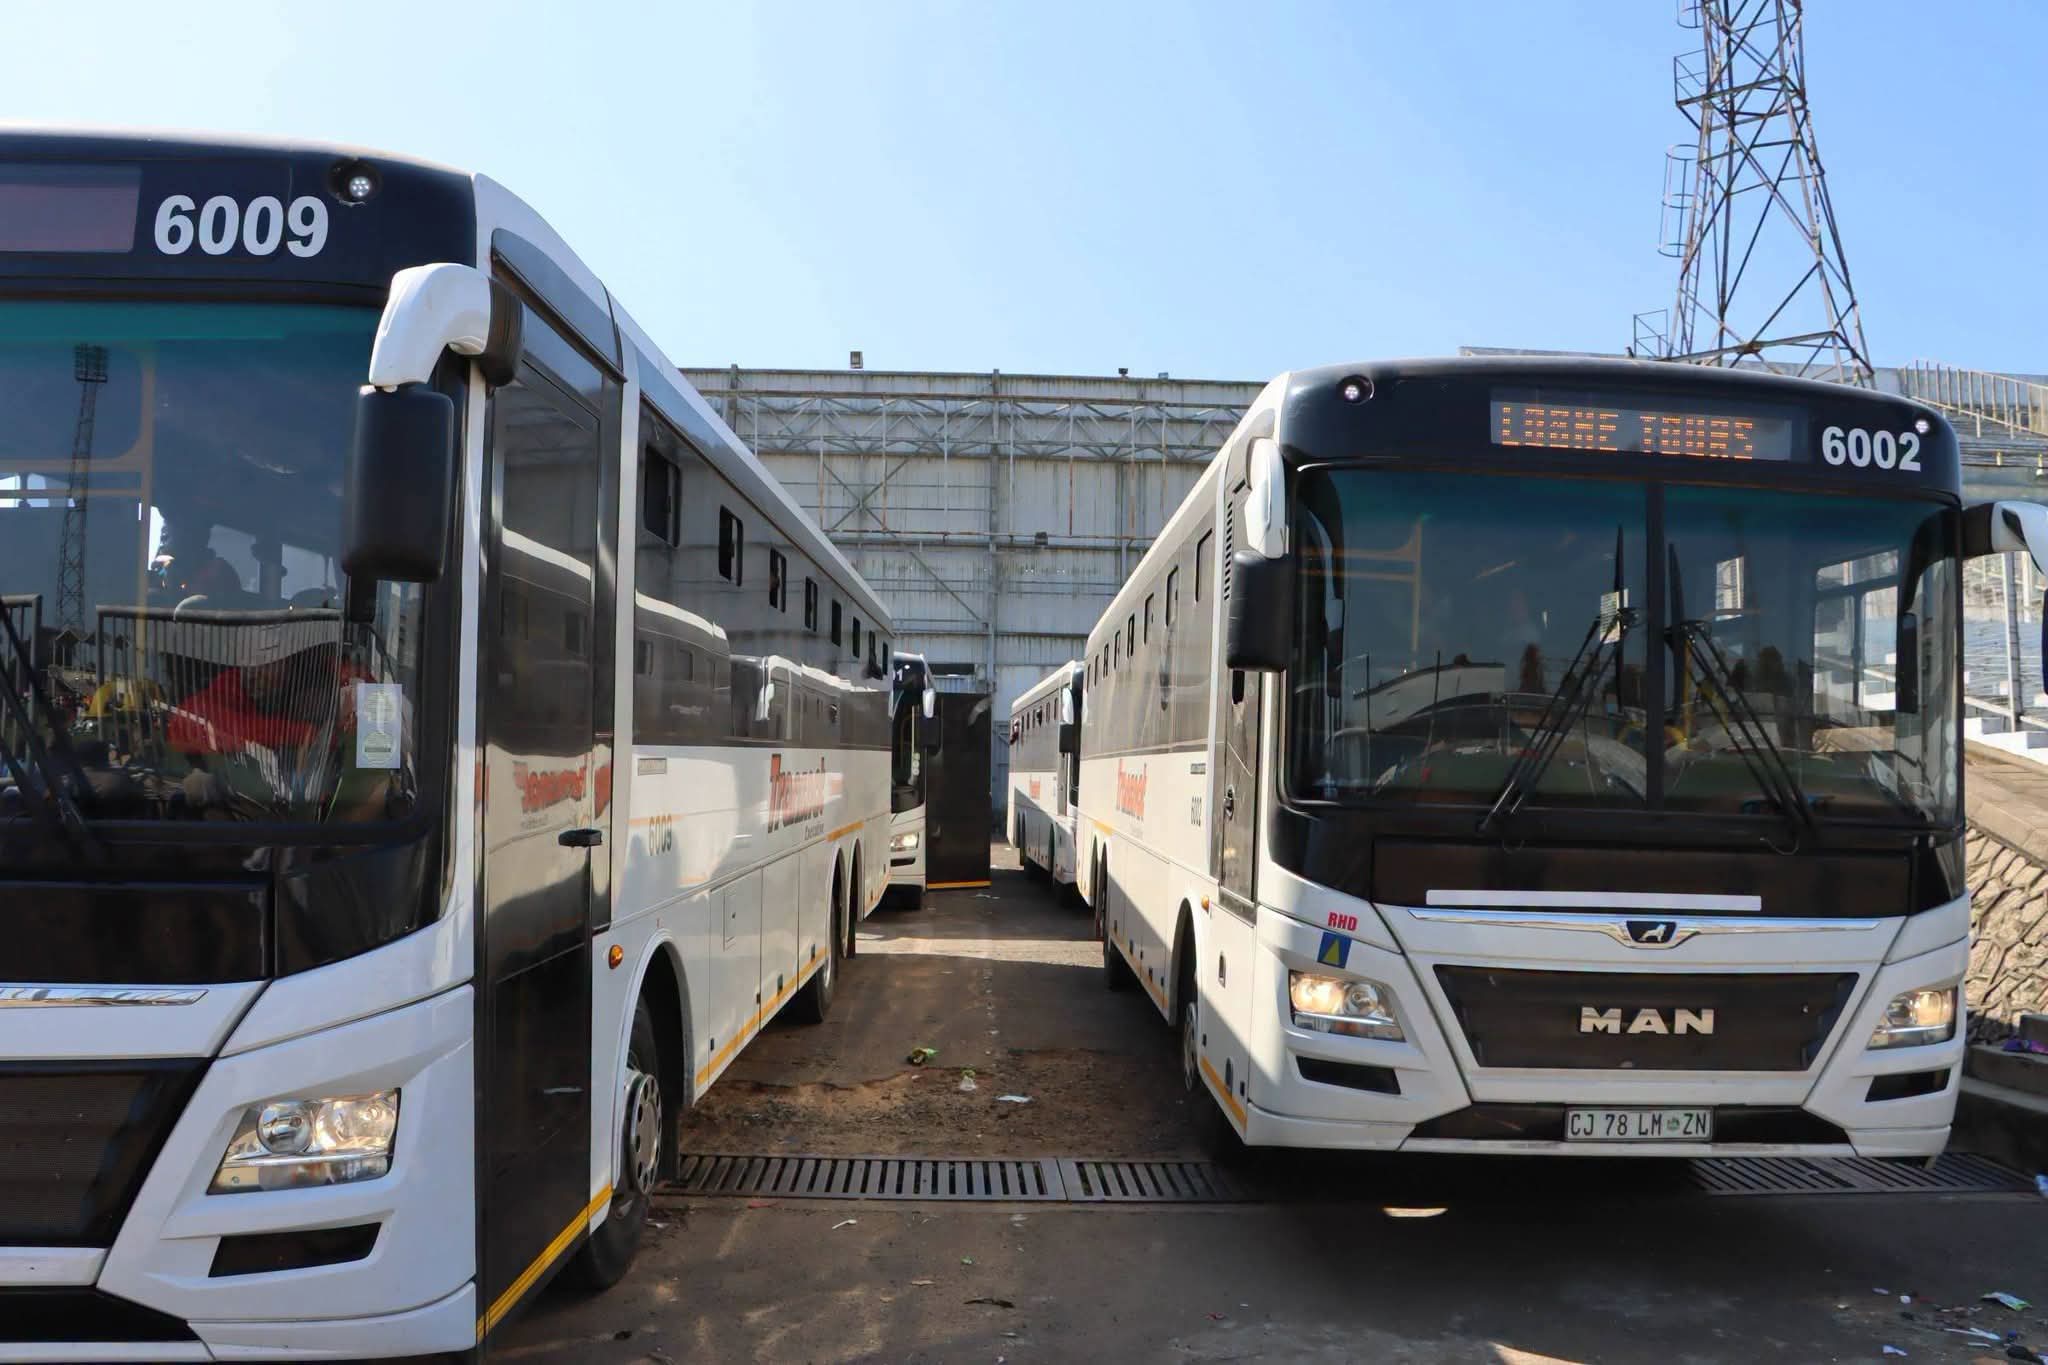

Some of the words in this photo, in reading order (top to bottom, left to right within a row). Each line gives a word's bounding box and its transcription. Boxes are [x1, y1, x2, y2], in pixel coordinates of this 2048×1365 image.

[154, 194, 329, 258] 6009
[1821, 425, 1922, 472] 6002
[648, 814, 673, 856] 6009
[1327, 912, 1358, 931] RHD
[1580, 1006, 1715, 1035] MAN
[1570, 1113, 1594, 1136] CJ
[1605, 1113, 1628, 1136] 78
[1638, 1113, 1662, 1136] LM
[1683, 1112, 1707, 1135] ZN
